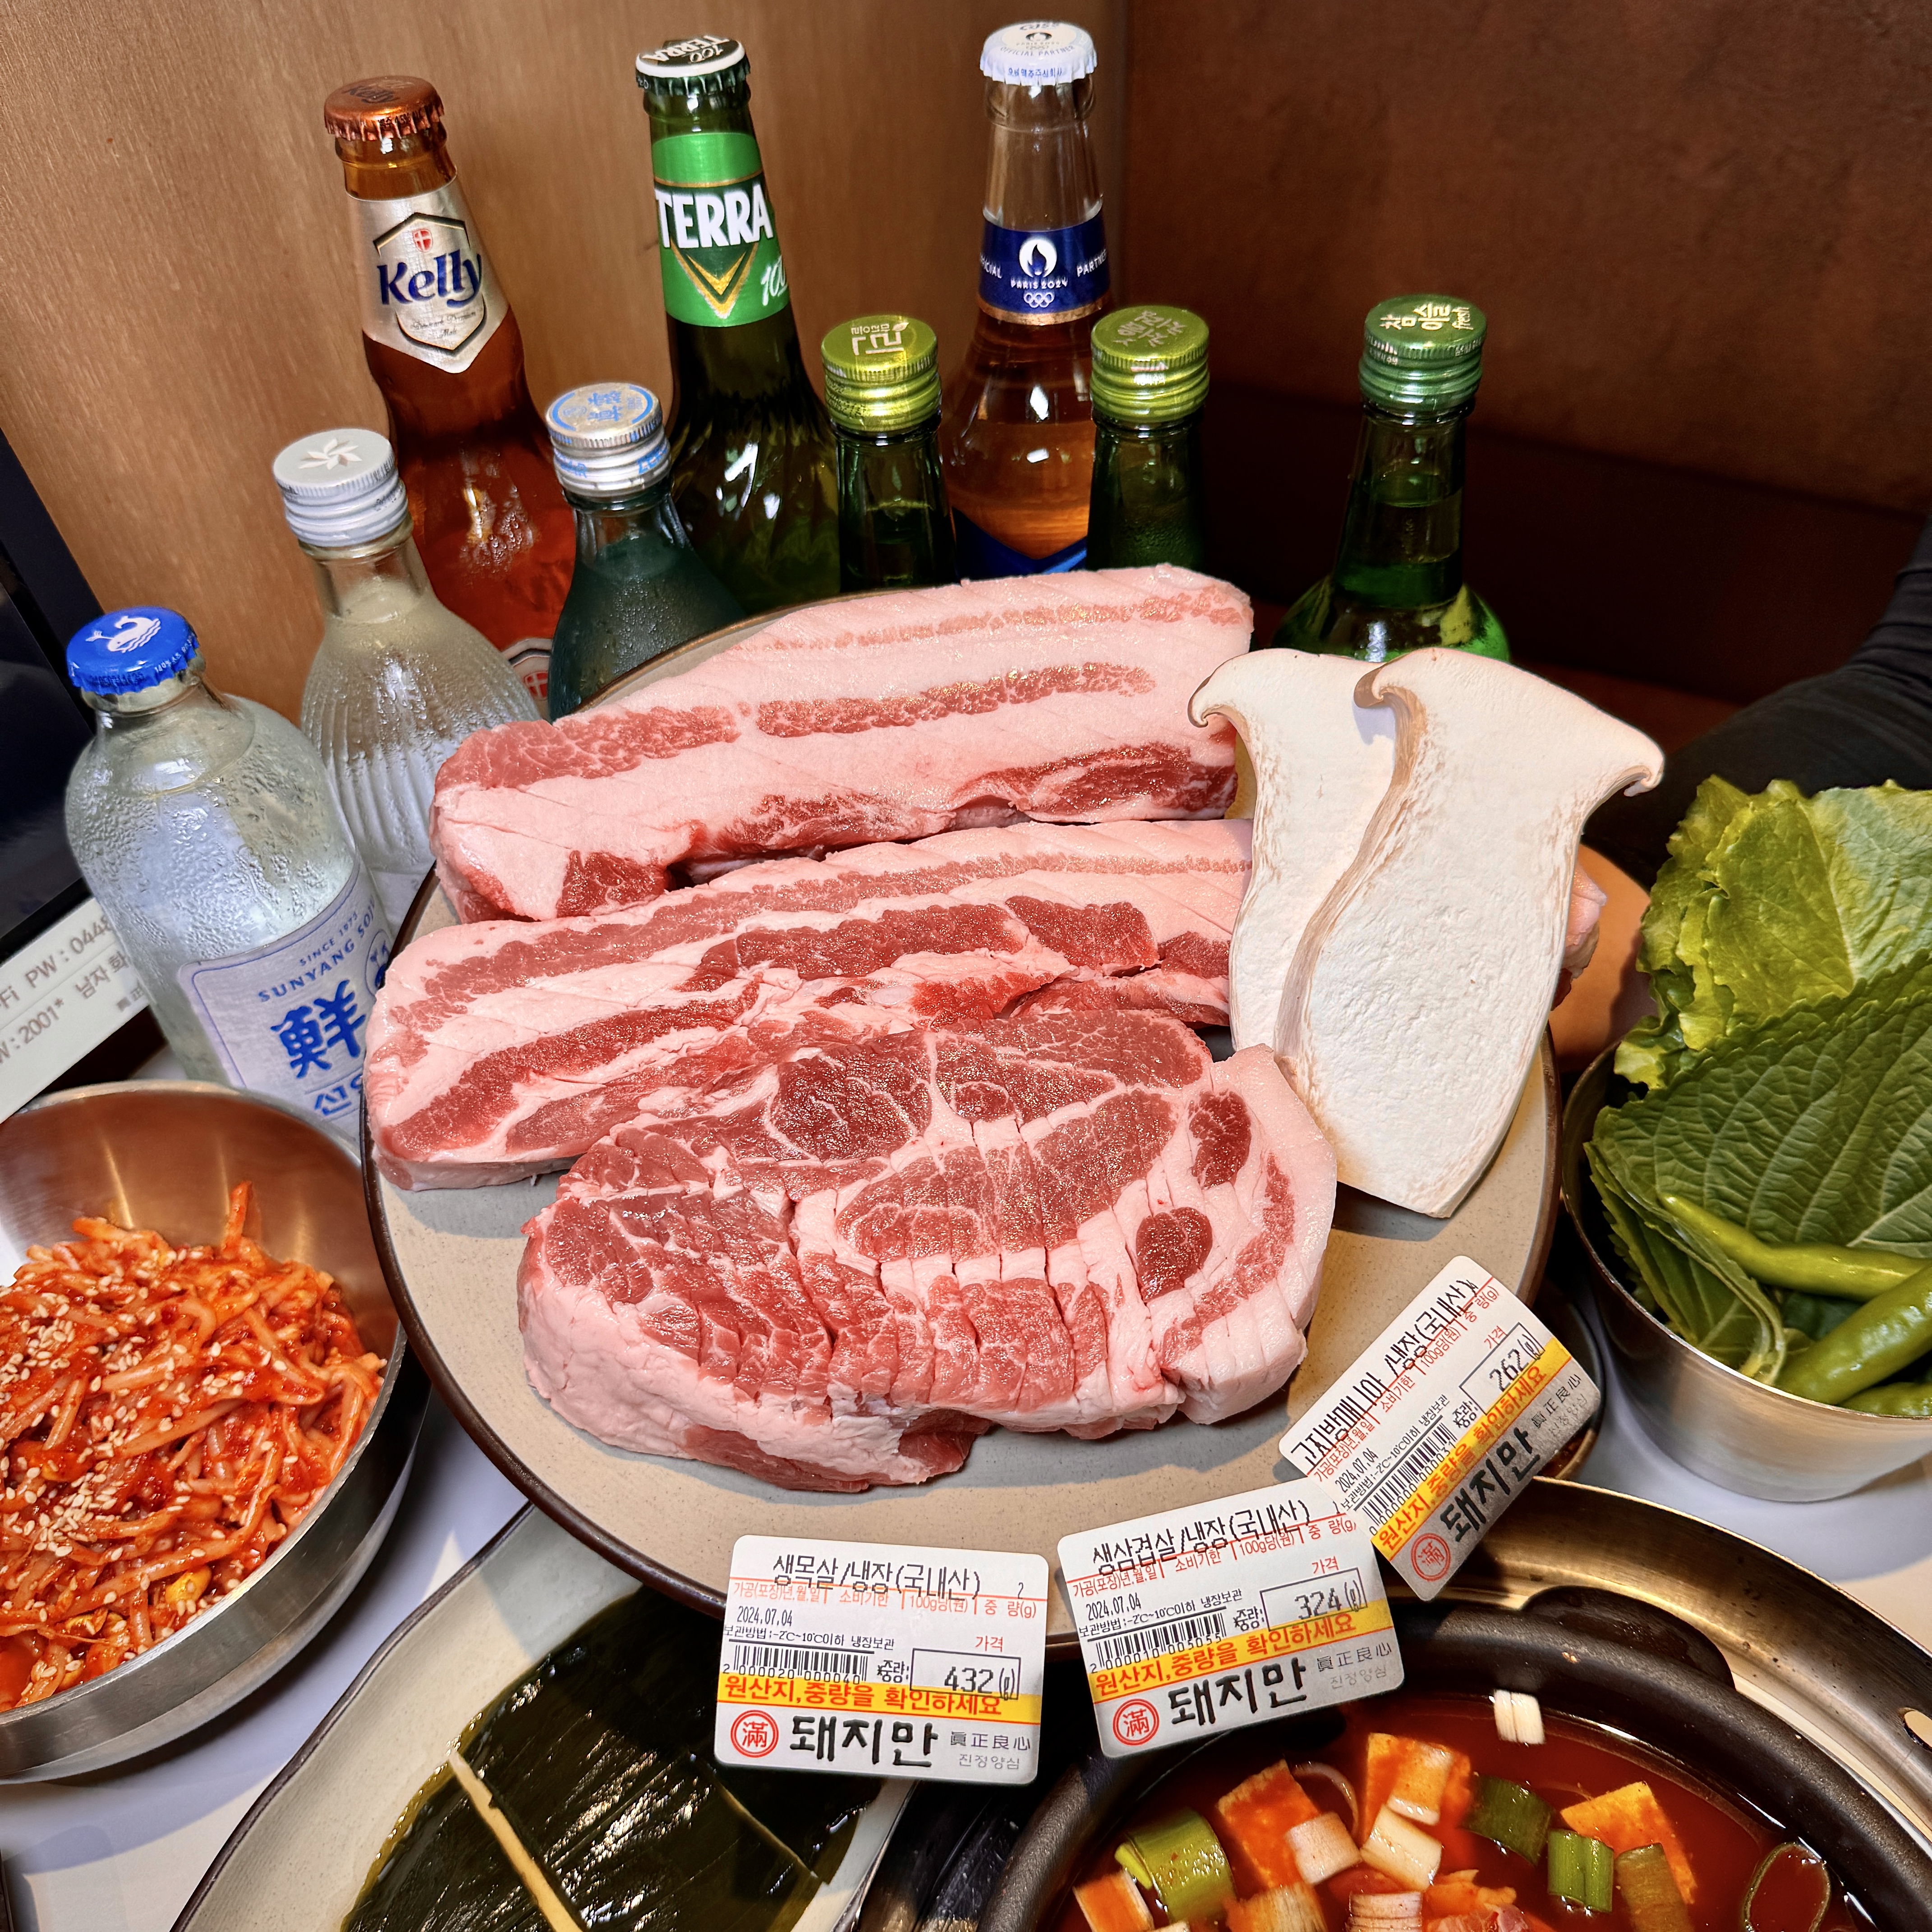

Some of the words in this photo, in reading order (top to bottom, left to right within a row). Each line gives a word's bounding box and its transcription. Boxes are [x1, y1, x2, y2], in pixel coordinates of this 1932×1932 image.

[642, 35, 730, 62] TERRA
[1038, 45, 1075, 56] PARTNER
[654, 182, 774, 248] TERRA
[377, 249, 482, 308] Kelly
[1010, 277, 1038, 289] PARIS
[1041, 276, 1068, 289] 2024
[299, 937, 336, 966] SINCE
[25, 955, 57, 988] PW
[75, 965, 111, 1000] 남자
[258, 939, 355, 1003] SUNYANG
[271, 980, 366, 1079] 鮮
[1484, 1325, 1509, 1349] 가격
[1380, 1375, 1416, 1413] 소비기한
[1473, 1366, 1546, 1443] 확인하세요
[1418, 1394, 1450, 1426] 냉장보관
[1335, 1447, 1379, 1493] 2024.07.04
[1440, 1427, 1540, 1542] 돼지만
[1175, 1549, 1221, 1572] 소비기한
[1311, 1556, 1339, 1574] 가격
[839, 1589, 889, 1607] 소비기한
[1086, 1592, 1141, 1621] 2024.07.04
[1201, 1588, 1242, 1609] 냉장보관
[736, 1605, 793, 1626] 2024.07.04
[851, 1635, 894, 1651] 냉장보관
[975, 1635, 1003, 1652] 가격
[1246, 1613, 1357, 1655] 확인하세요
[725, 1675, 874, 1707] 원산지,중량을
[884, 1687, 1002, 1715] 확인하세요
[1168, 1657, 1307, 1726] 돼지만
[742, 1721, 768, 1748] 滿
[1122, 1708, 1150, 1738] 滿
[790, 1715, 939, 1767] 돼지만
[950, 1731, 1030, 1751] 眞正良心
[959, 1753, 1020, 1770] 진정양심
